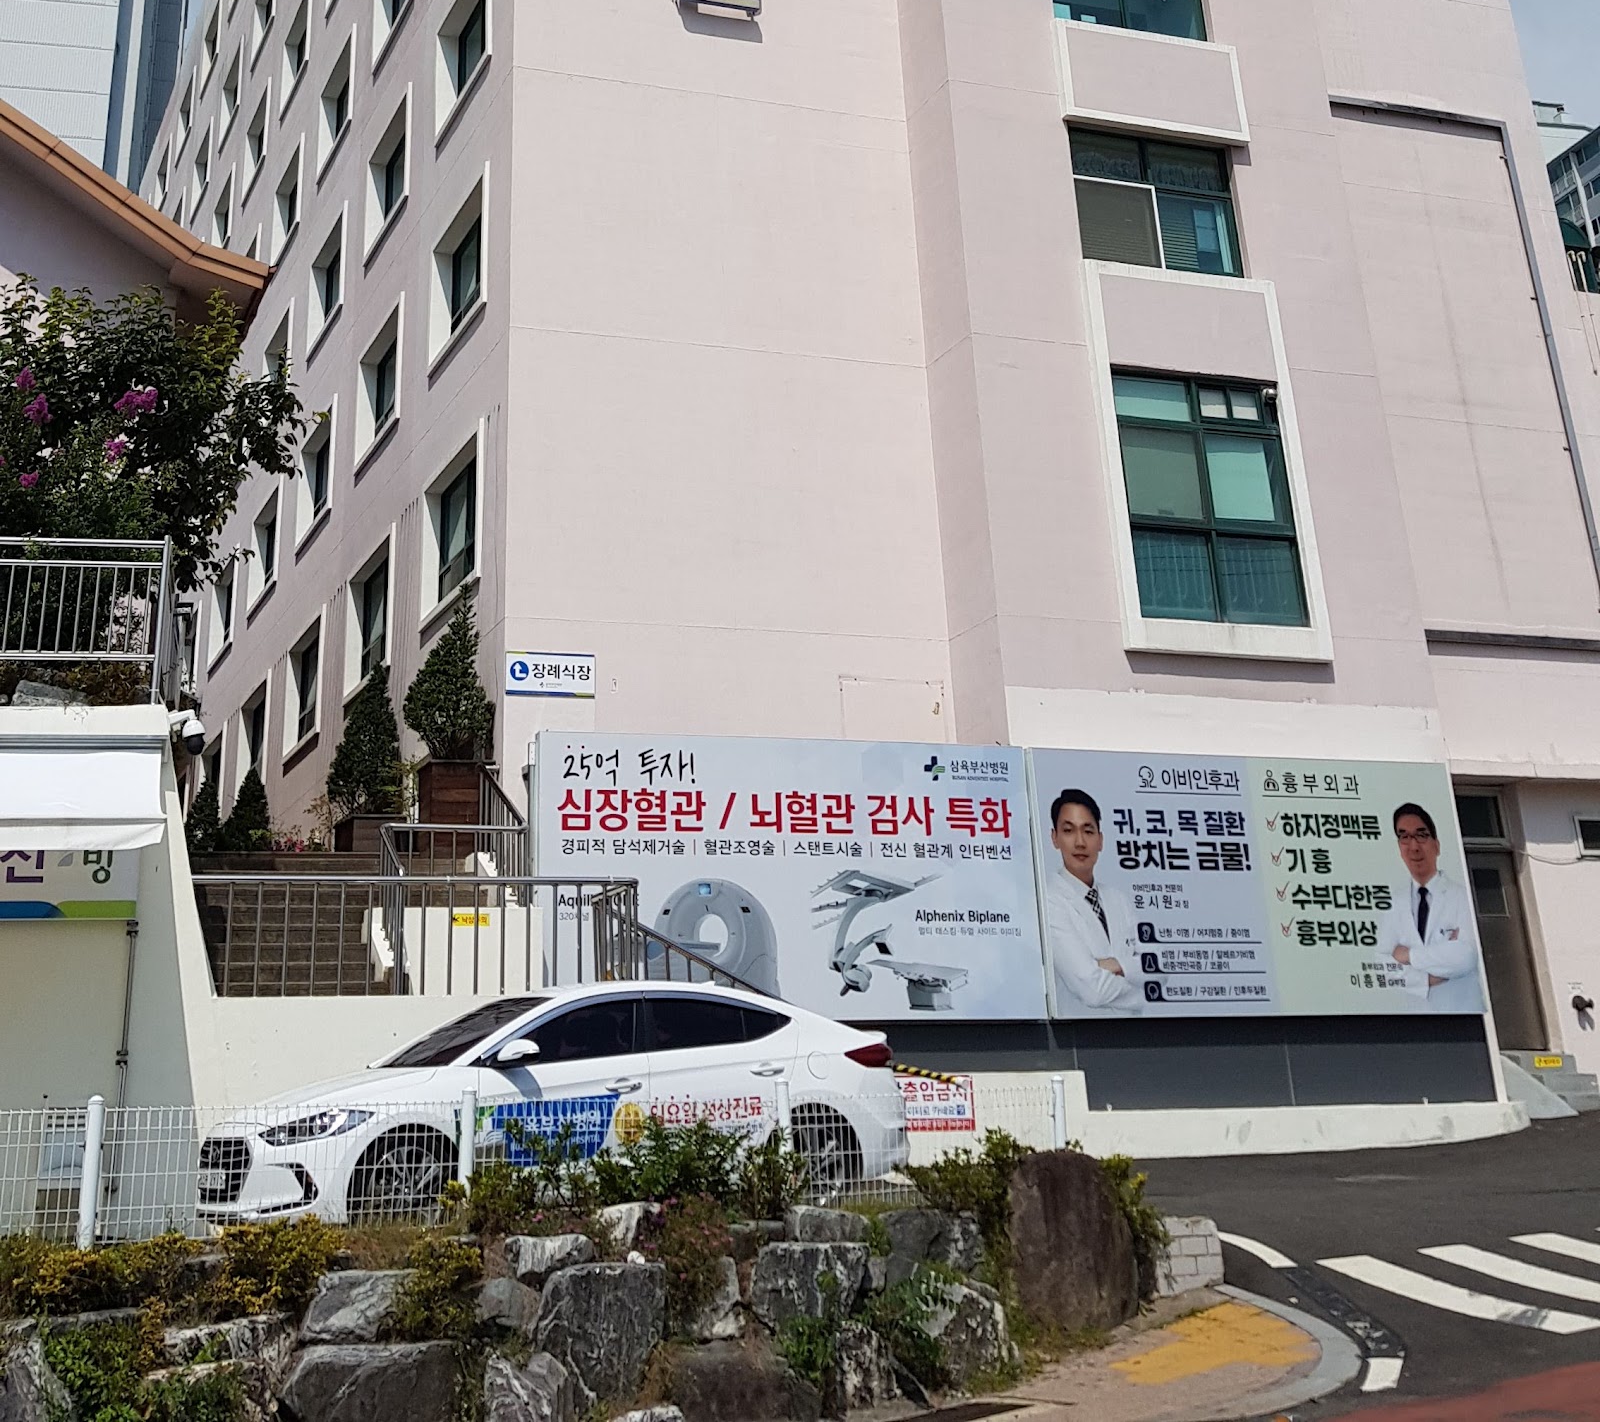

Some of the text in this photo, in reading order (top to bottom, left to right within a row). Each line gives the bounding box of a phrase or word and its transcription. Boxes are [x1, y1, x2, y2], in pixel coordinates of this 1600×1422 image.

[532, 663, 592, 681] 장례식장
[563, 749, 696, 786] 25억 투자!
[950, 760, 1009, 775] 삼육부산병원
[1162, 768, 1240, 791] 이비인후과
[1282, 772, 1359, 795] 흉부외과
[557, 788, 706, 832] 심장혈관
[750, 791, 856, 834] 뇌혈관
[867, 795, 935, 836] 검사
[946, 797, 1012, 838] 특화
[1113, 809, 1245, 837] 귀, 코, 목 질환
[1280, 813, 1381, 840] 하지정맥류
[561, 838, 605, 855] 경피적
[612, 838, 685, 855] 담석제거술
[704, 838, 775, 855] 혈관조영술
[880, 842, 907, 858] 전신
[913, 842, 953, 859] 혈관계
[959, 844, 1012, 860] 인터벤션
[1116, 840, 1251, 871] 방치는 금물!
[1285, 848, 1332, 874] 기흉
[1292, 884, 1392, 911] 수부다한증
[915, 910, 1010, 924] Alphenix Biplane
[1296, 920, 1378, 947] 흉부외상
